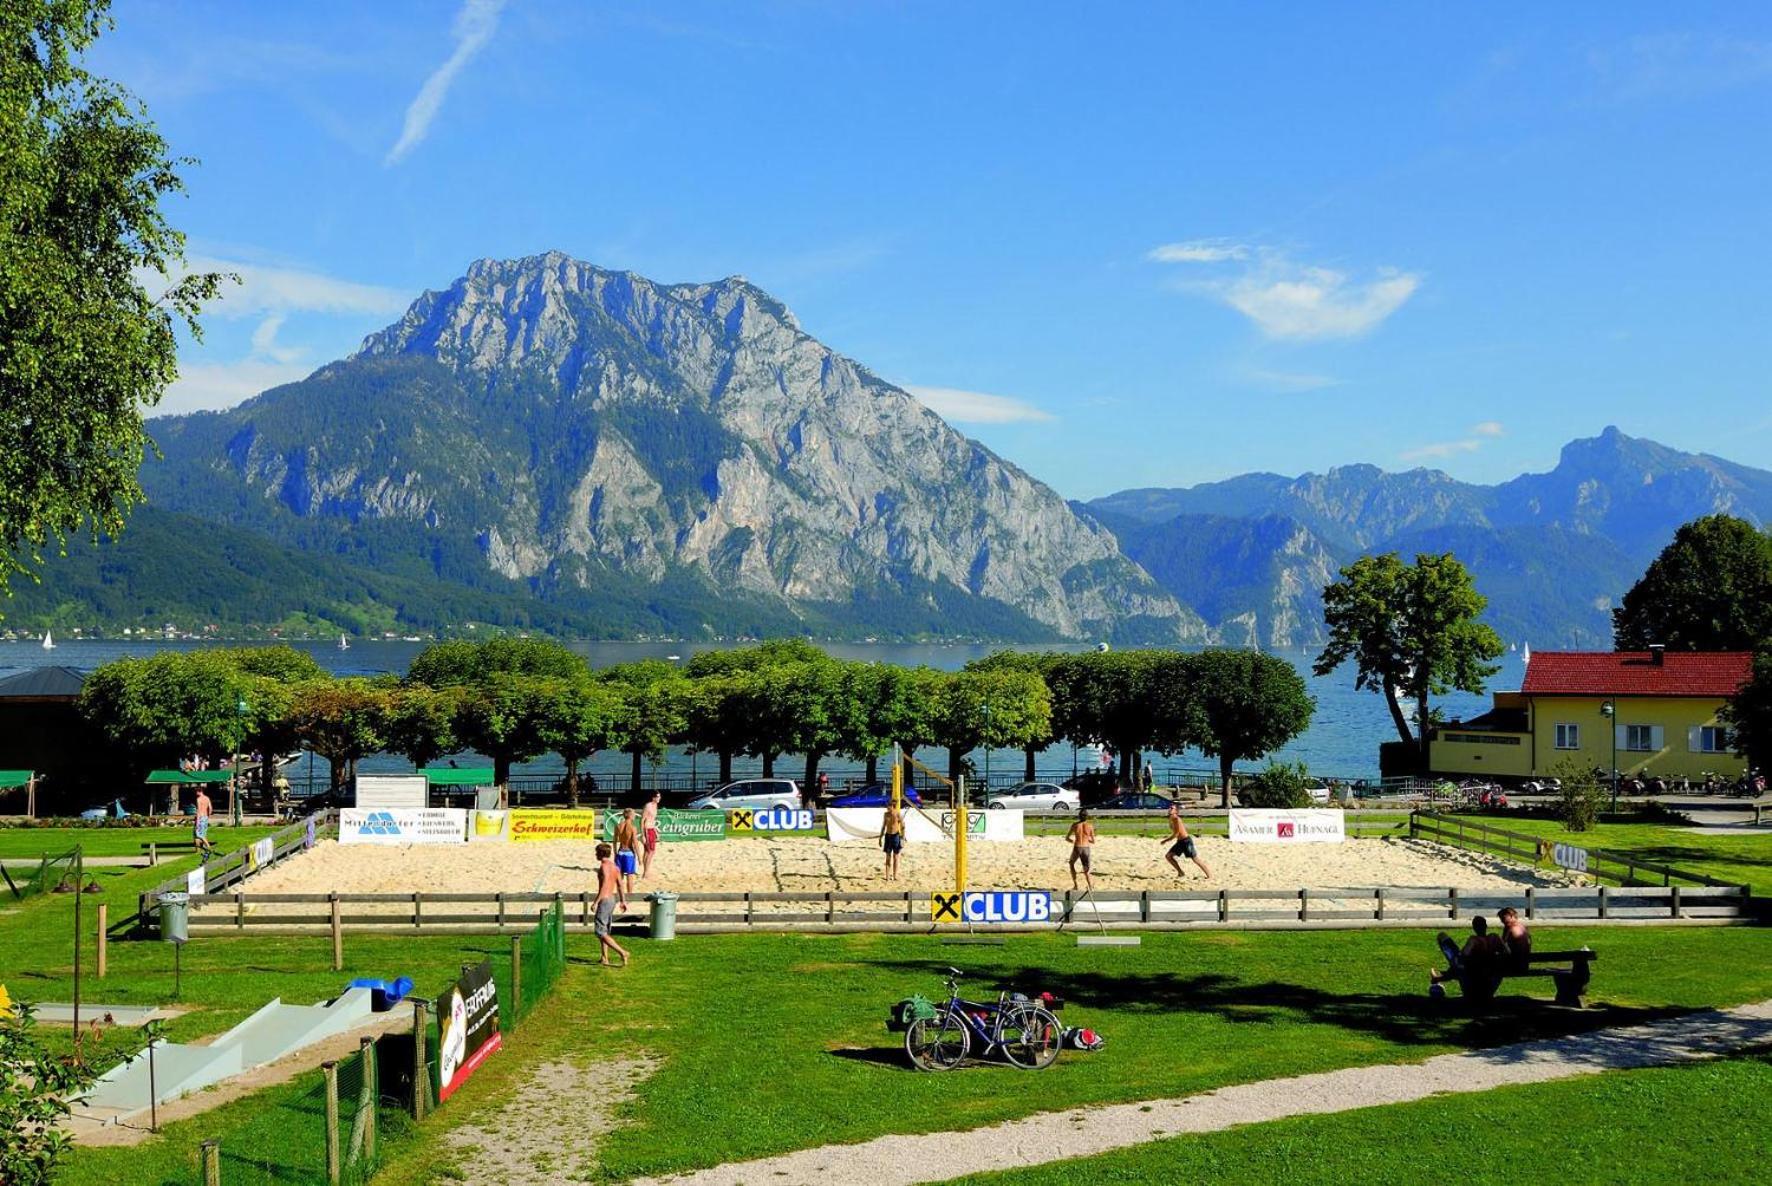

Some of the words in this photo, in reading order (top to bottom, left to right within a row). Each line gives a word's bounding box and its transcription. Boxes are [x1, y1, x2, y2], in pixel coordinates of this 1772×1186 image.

[512, 821, 592, 835] Schweizerhof
[655, 818, 723, 836] Reingruber
[753, 810, 813, 830] CLUB
[1555, 844, 1587, 871] CLUB
[964, 892, 1049, 921] CLUB
